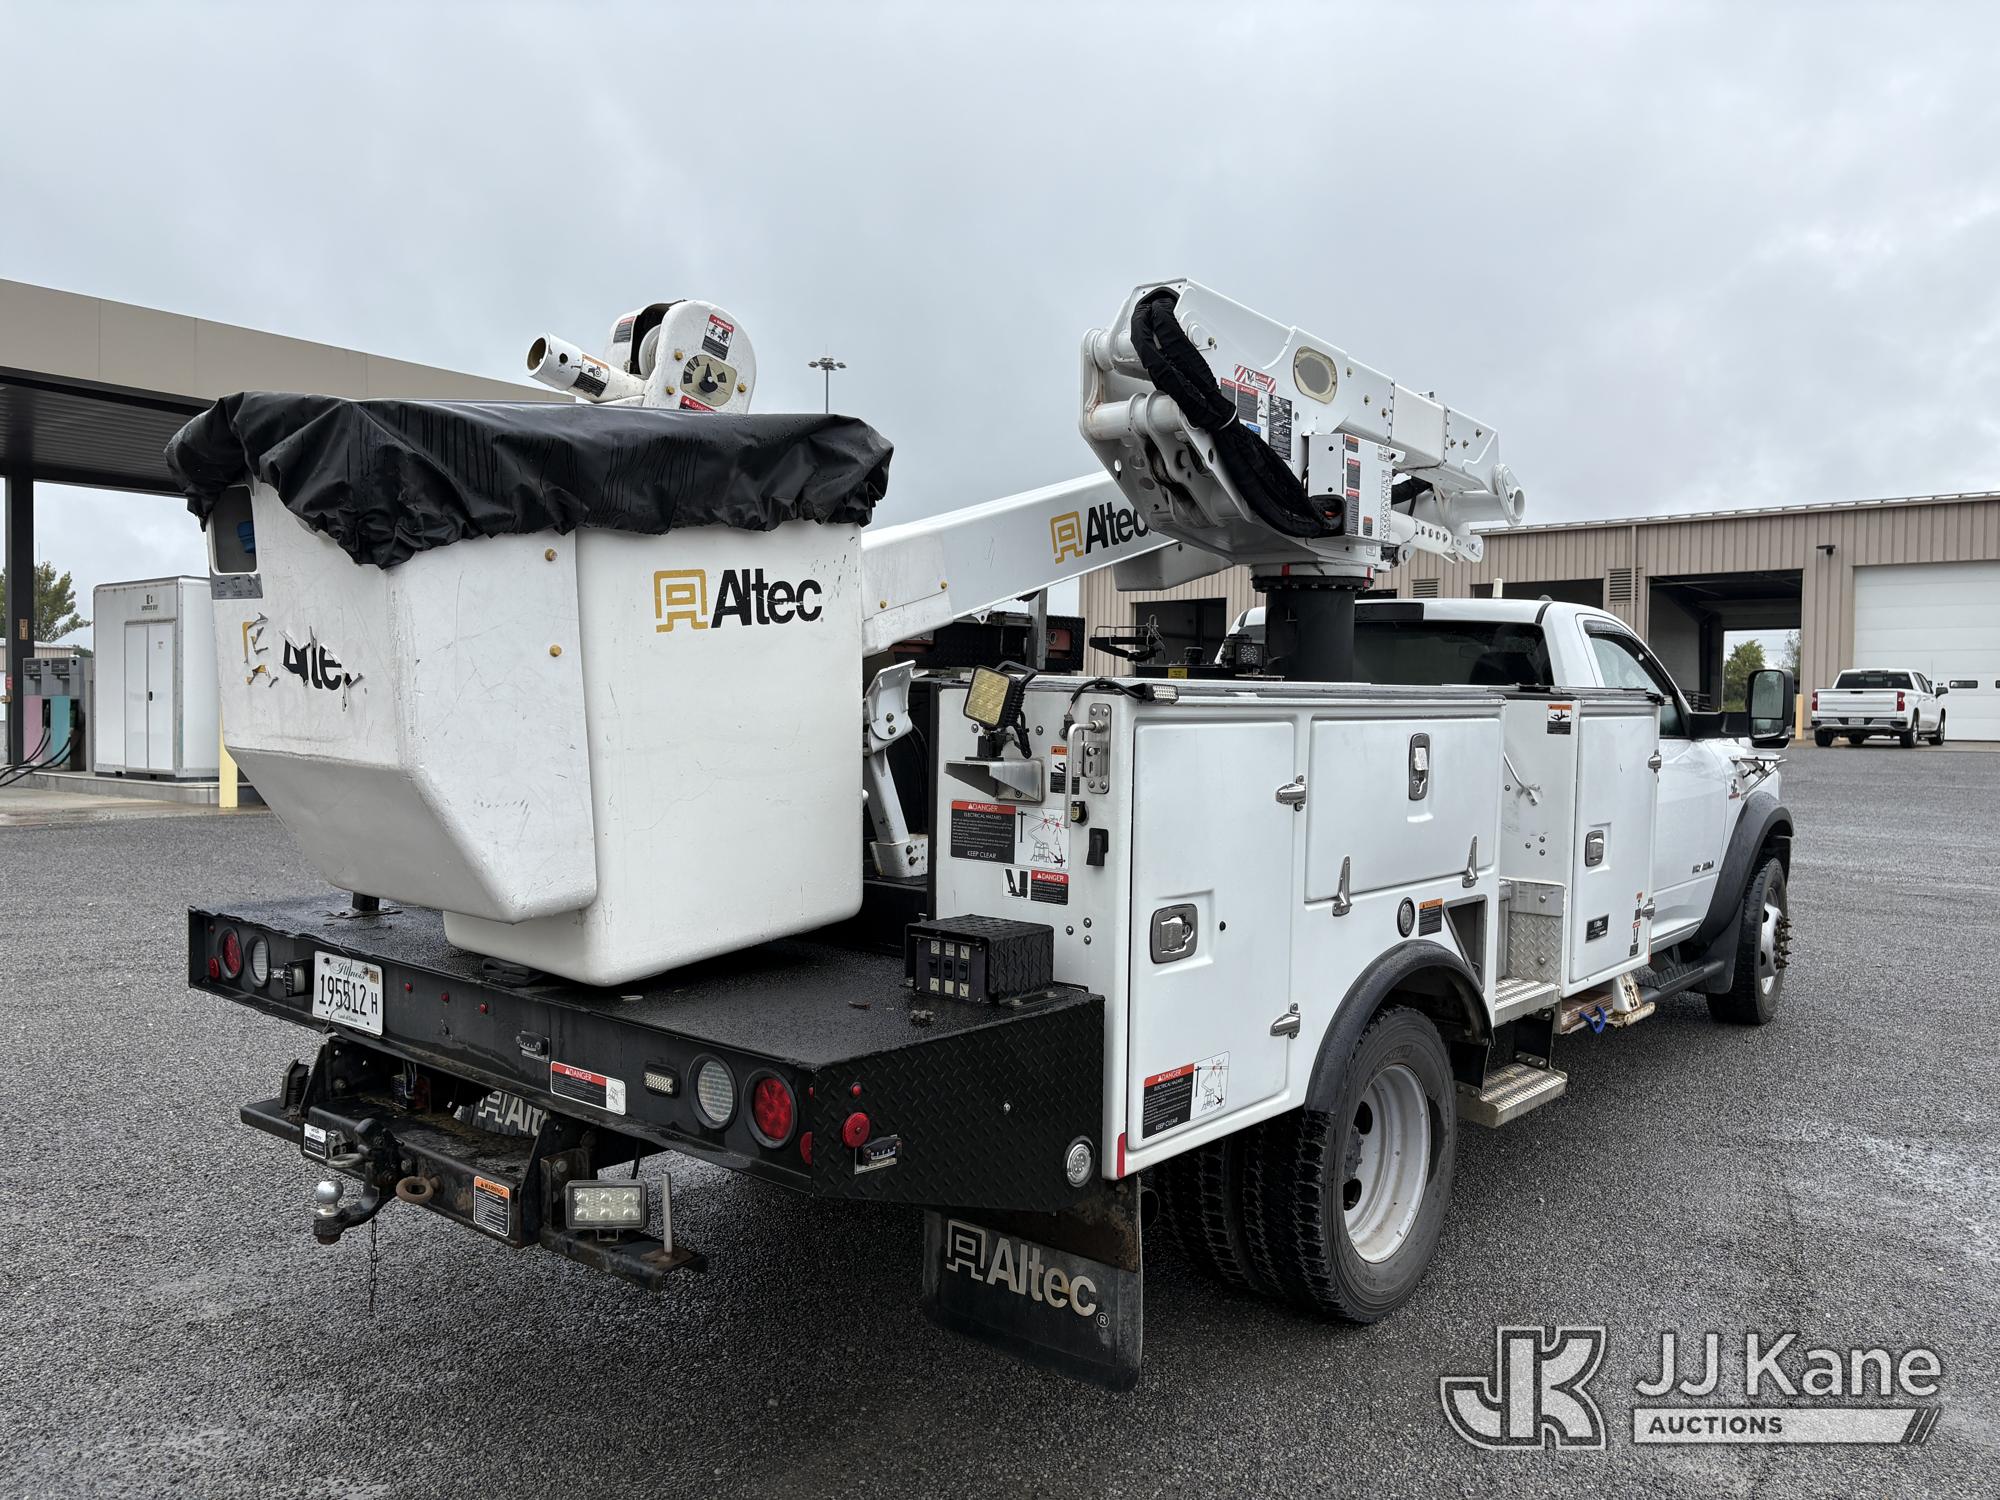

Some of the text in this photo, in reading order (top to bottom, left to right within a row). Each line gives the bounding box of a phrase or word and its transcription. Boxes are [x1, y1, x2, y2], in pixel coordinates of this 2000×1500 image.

[711, 568, 822, 628] Altec
[972, 803, 999, 812] DANGER
[980, 851, 997, 859] CLEAR
[1041, 872, 1065, 882] DANGER
[319, 974, 378, 1016] 195512 H
[569, 1068, 592, 1081] DANGER
[1161, 1068, 1182, 1080] DANGER
[986, 1237, 1096, 1317] Altec
